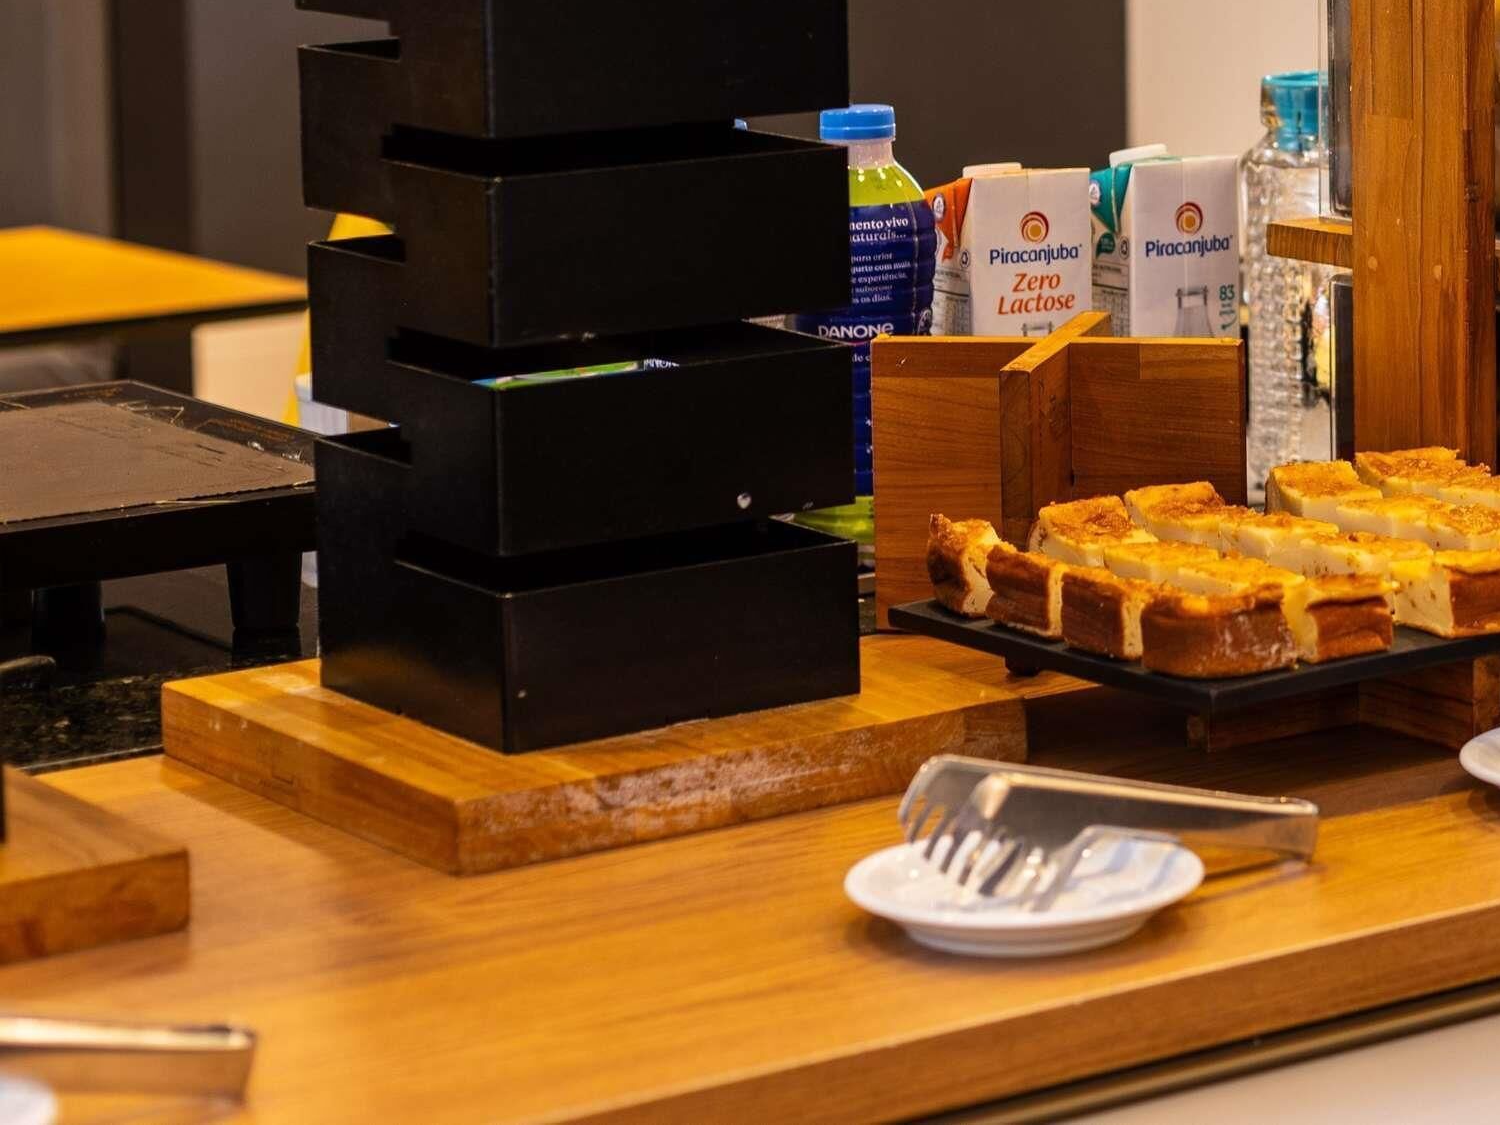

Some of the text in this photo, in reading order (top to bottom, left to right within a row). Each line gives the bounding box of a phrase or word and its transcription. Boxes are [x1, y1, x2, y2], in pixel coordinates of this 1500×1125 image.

[886, 217, 909, 228] vivo
[990, 243, 1079, 265] Piracanjuba
[1146, 235, 1230, 258] Piracanjuba
[1012, 272, 1061, 293] Zero
[1219, 284, 1235, 301] 83
[998, 293, 1076, 315] Lactose
